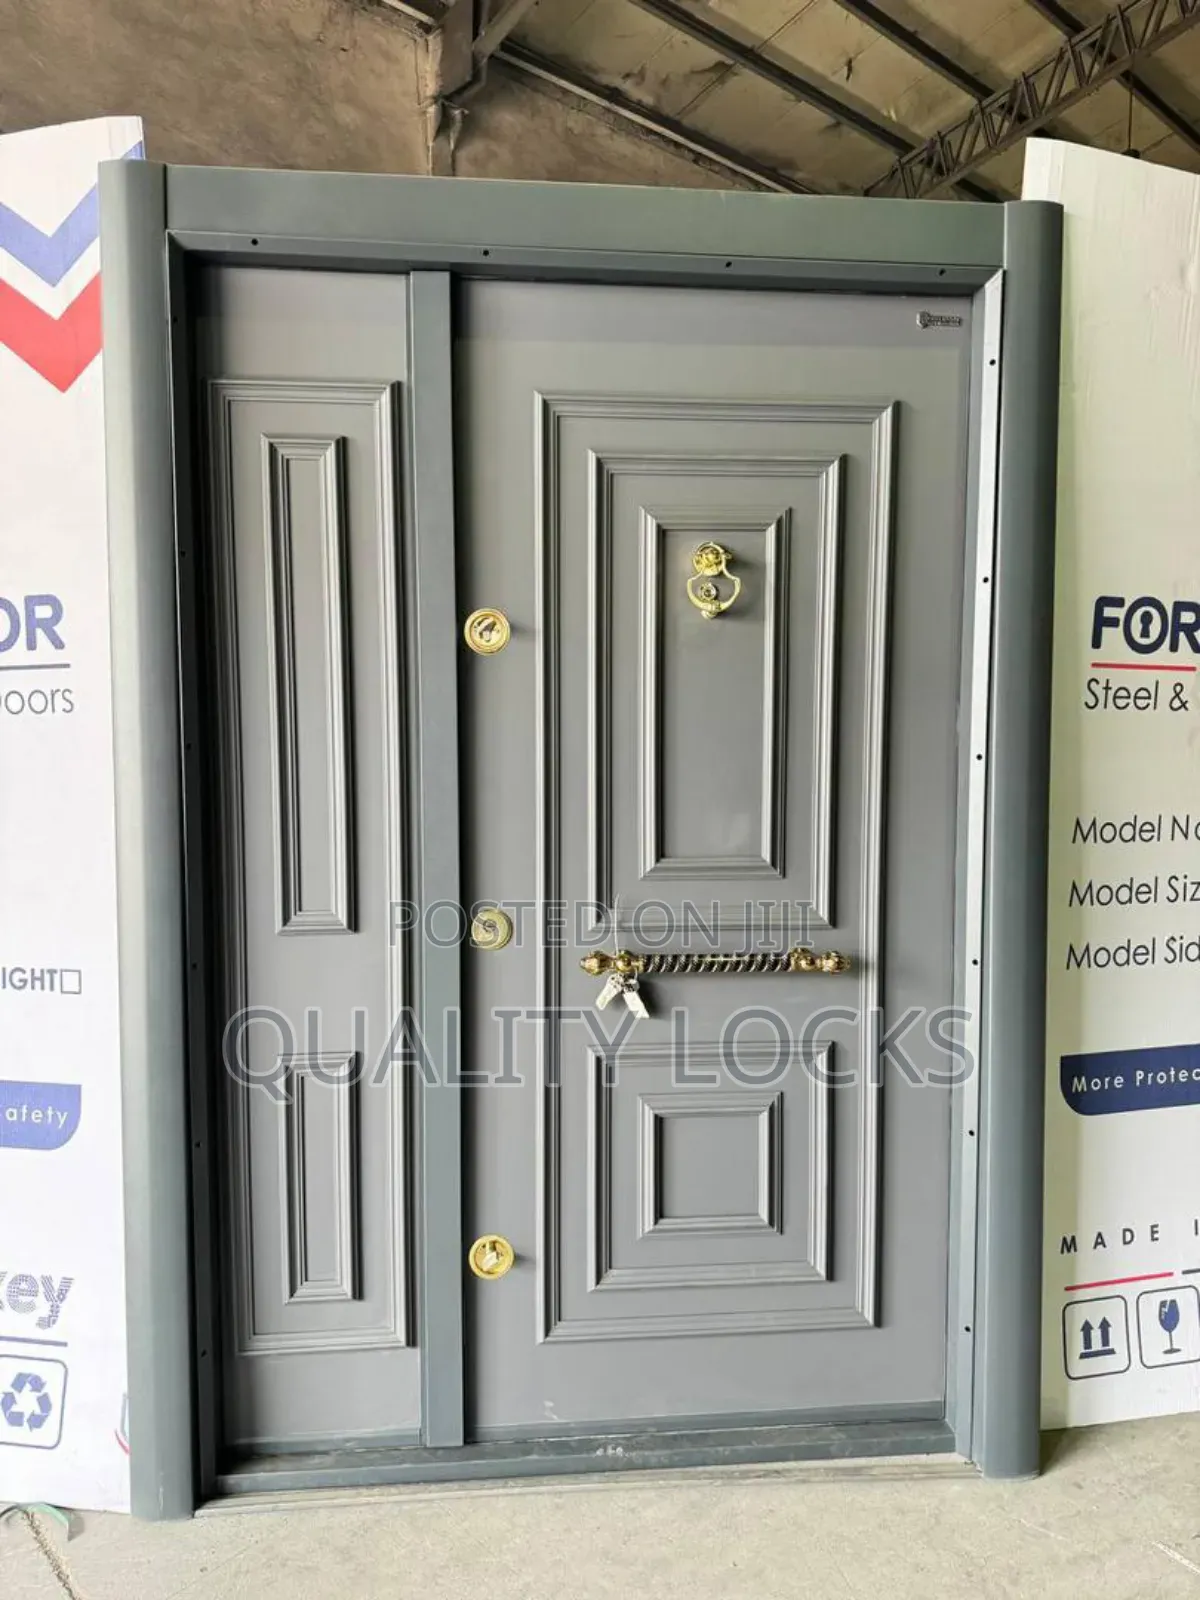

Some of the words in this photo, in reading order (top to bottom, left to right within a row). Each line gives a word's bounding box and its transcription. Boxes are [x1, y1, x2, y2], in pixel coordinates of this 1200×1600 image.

[1091, 596, 1200, 654] FOR
[0, 688, 74, 715] oors
[1084, 678, 1159, 710] Steel
[1169, 682, 1189, 711] &
[1072, 814, 1162, 844] Model
[1069, 876, 1158, 907] Model
[1166, 874, 1200, 903] Siz
[1066, 937, 1156, 970] Model
[1164, 935, 1200, 963] Sid
[2, 966, 58, 992] IGHT
[1072, 1076, 1124, 1093] More
[1136, 1067, 1200, 1086] Protec
[0, 1104, 68, 1129] afety
[1060, 1224, 1160, 1255] MADE
[0, 1271, 75, 1330] ey
